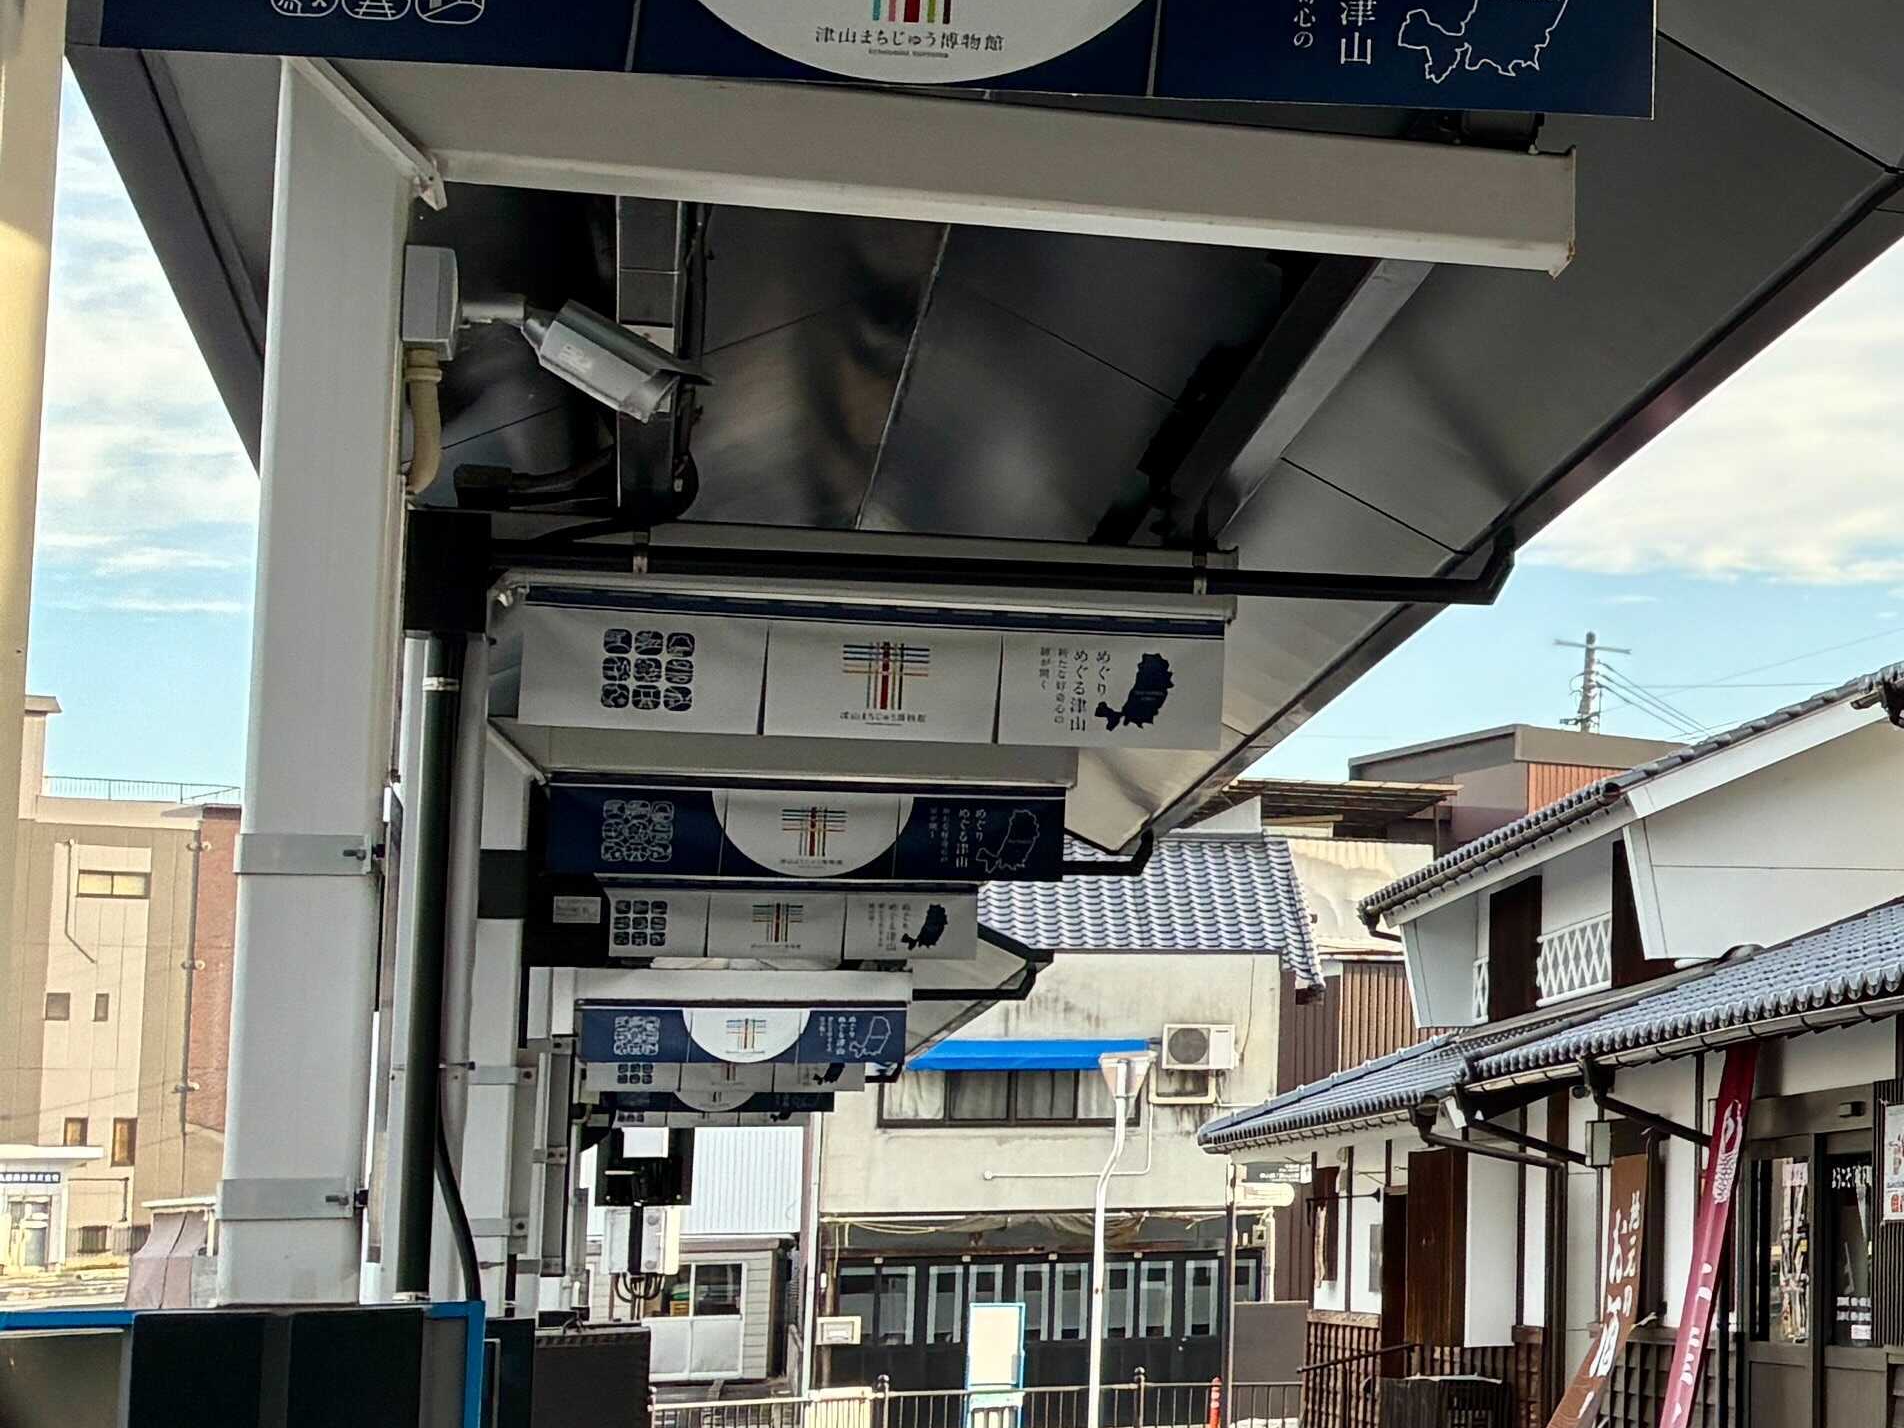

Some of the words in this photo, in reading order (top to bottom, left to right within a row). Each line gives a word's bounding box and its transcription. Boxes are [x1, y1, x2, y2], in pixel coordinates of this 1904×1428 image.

[815, 26, 1005, 52] 津山まちじゅう博物館
